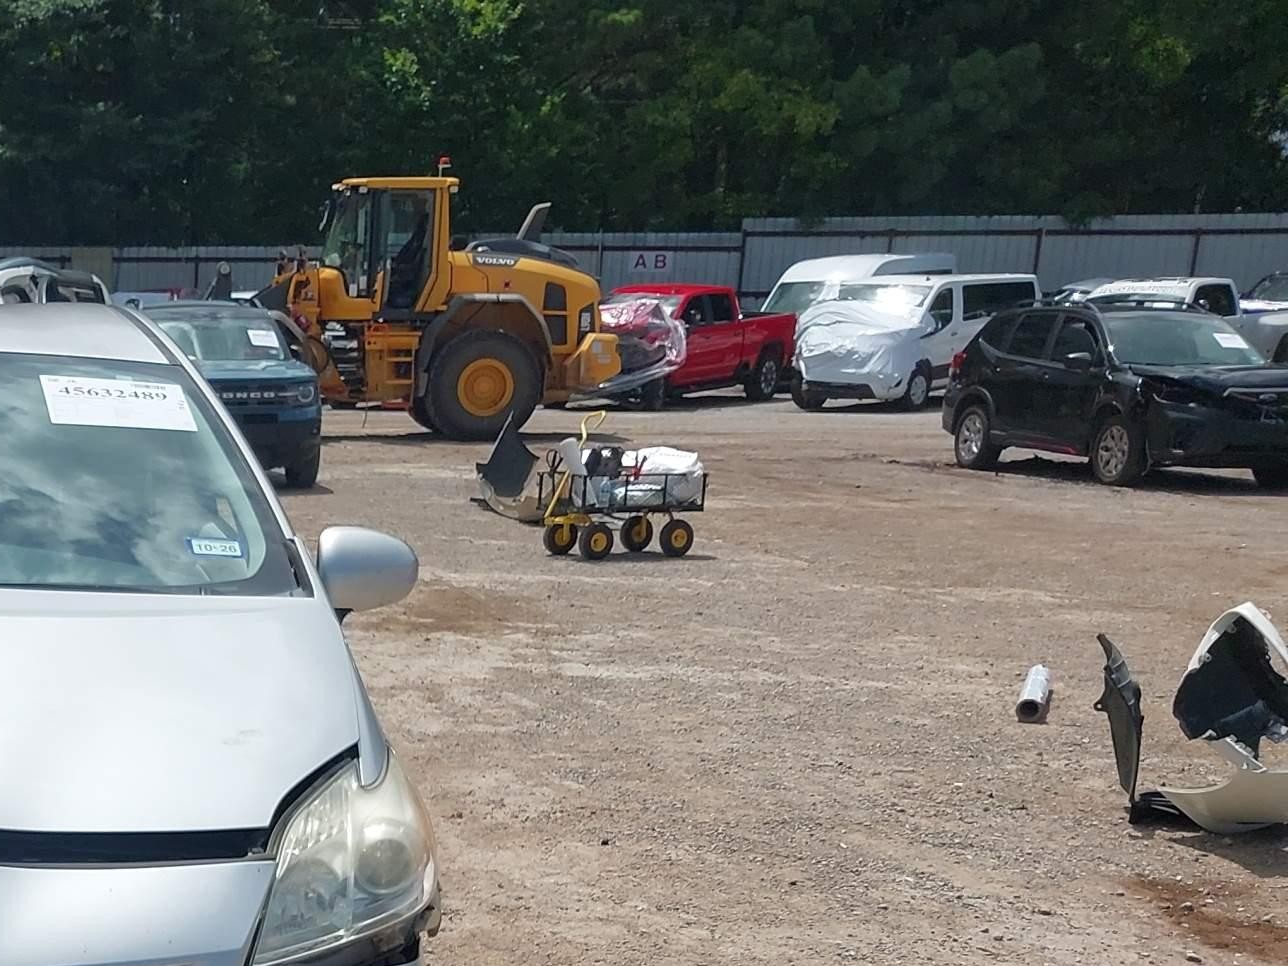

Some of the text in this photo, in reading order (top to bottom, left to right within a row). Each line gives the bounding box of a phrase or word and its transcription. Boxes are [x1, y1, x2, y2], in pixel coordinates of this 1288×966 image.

[476, 256, 515, 265] VOLVO
[634, 254, 667, 269] A B
[58, 386, 168, 401] 45632489
